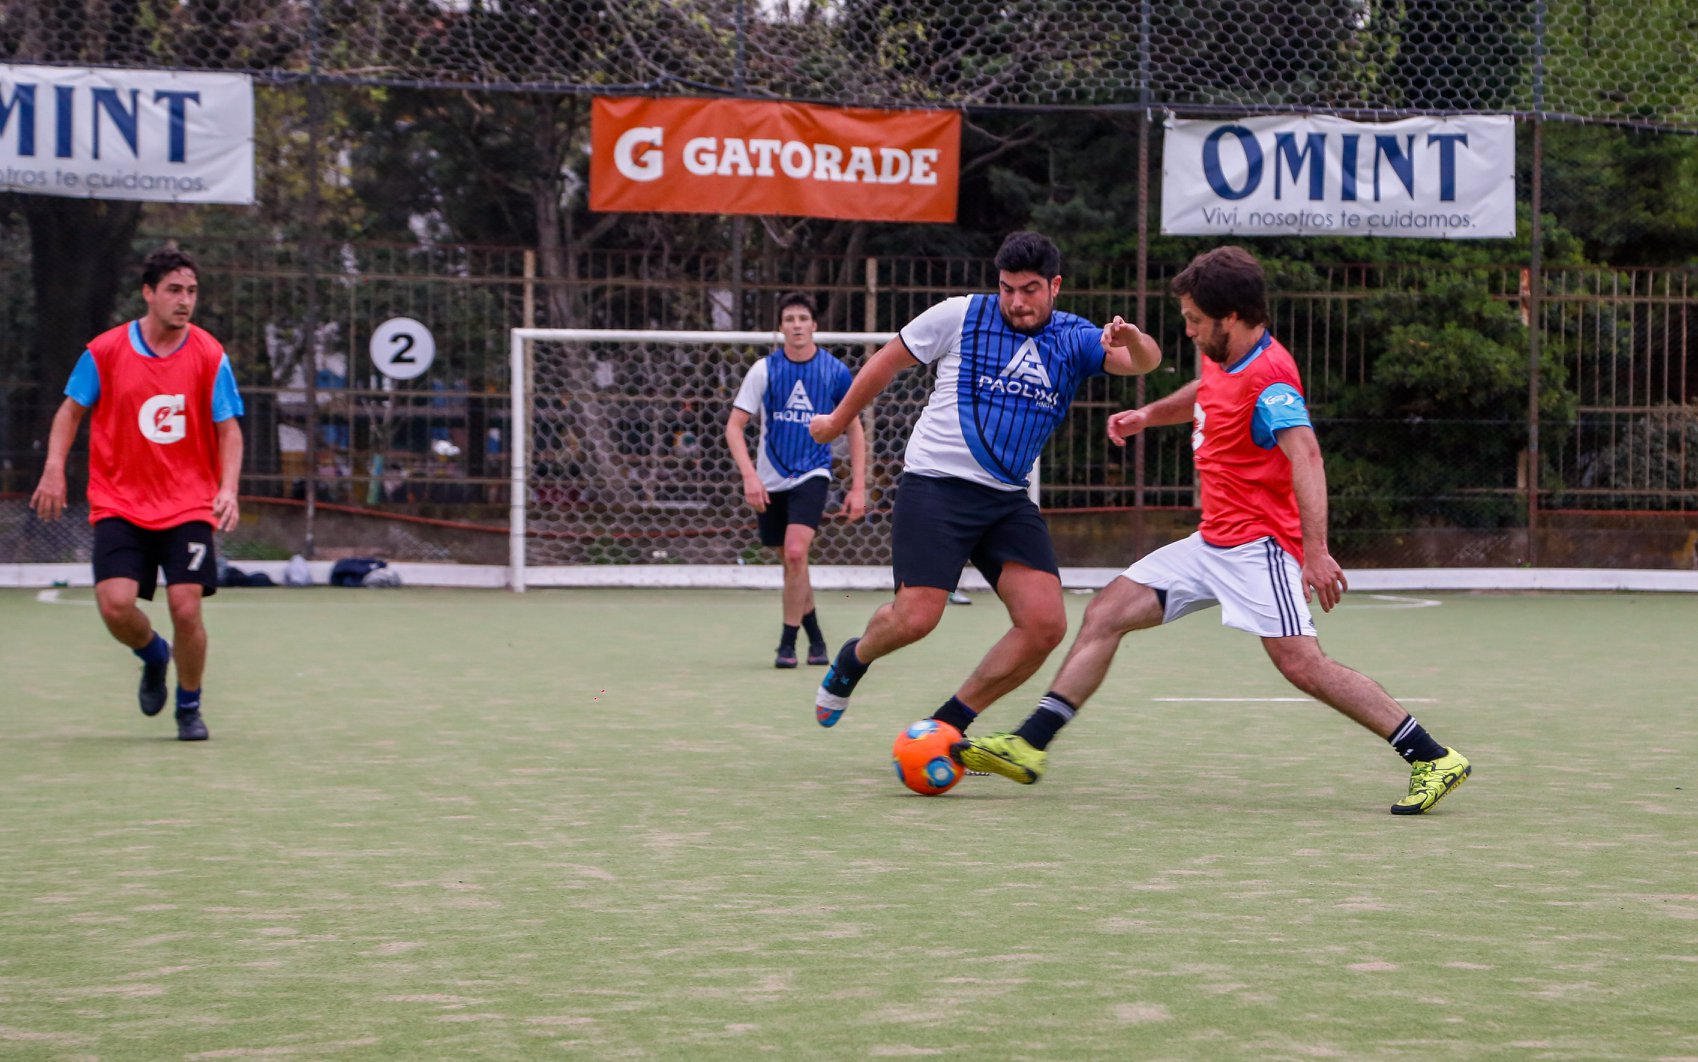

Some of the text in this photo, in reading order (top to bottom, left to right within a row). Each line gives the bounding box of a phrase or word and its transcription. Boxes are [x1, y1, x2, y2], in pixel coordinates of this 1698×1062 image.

[614, 126, 938, 185] G GATORADE
[1202, 125, 1469, 202] OMINT
[56, 167, 79, 187] te
[86, 170, 209, 191] cuidamos.
[1250, 209, 1333, 228] nosotros
[1340, 210, 1361, 228] te
[1367, 210, 1476, 229] cuidamos.
[389, 332, 416, 363] 2
[138, 394, 186, 444] G
[188, 542, 206, 571] 7
